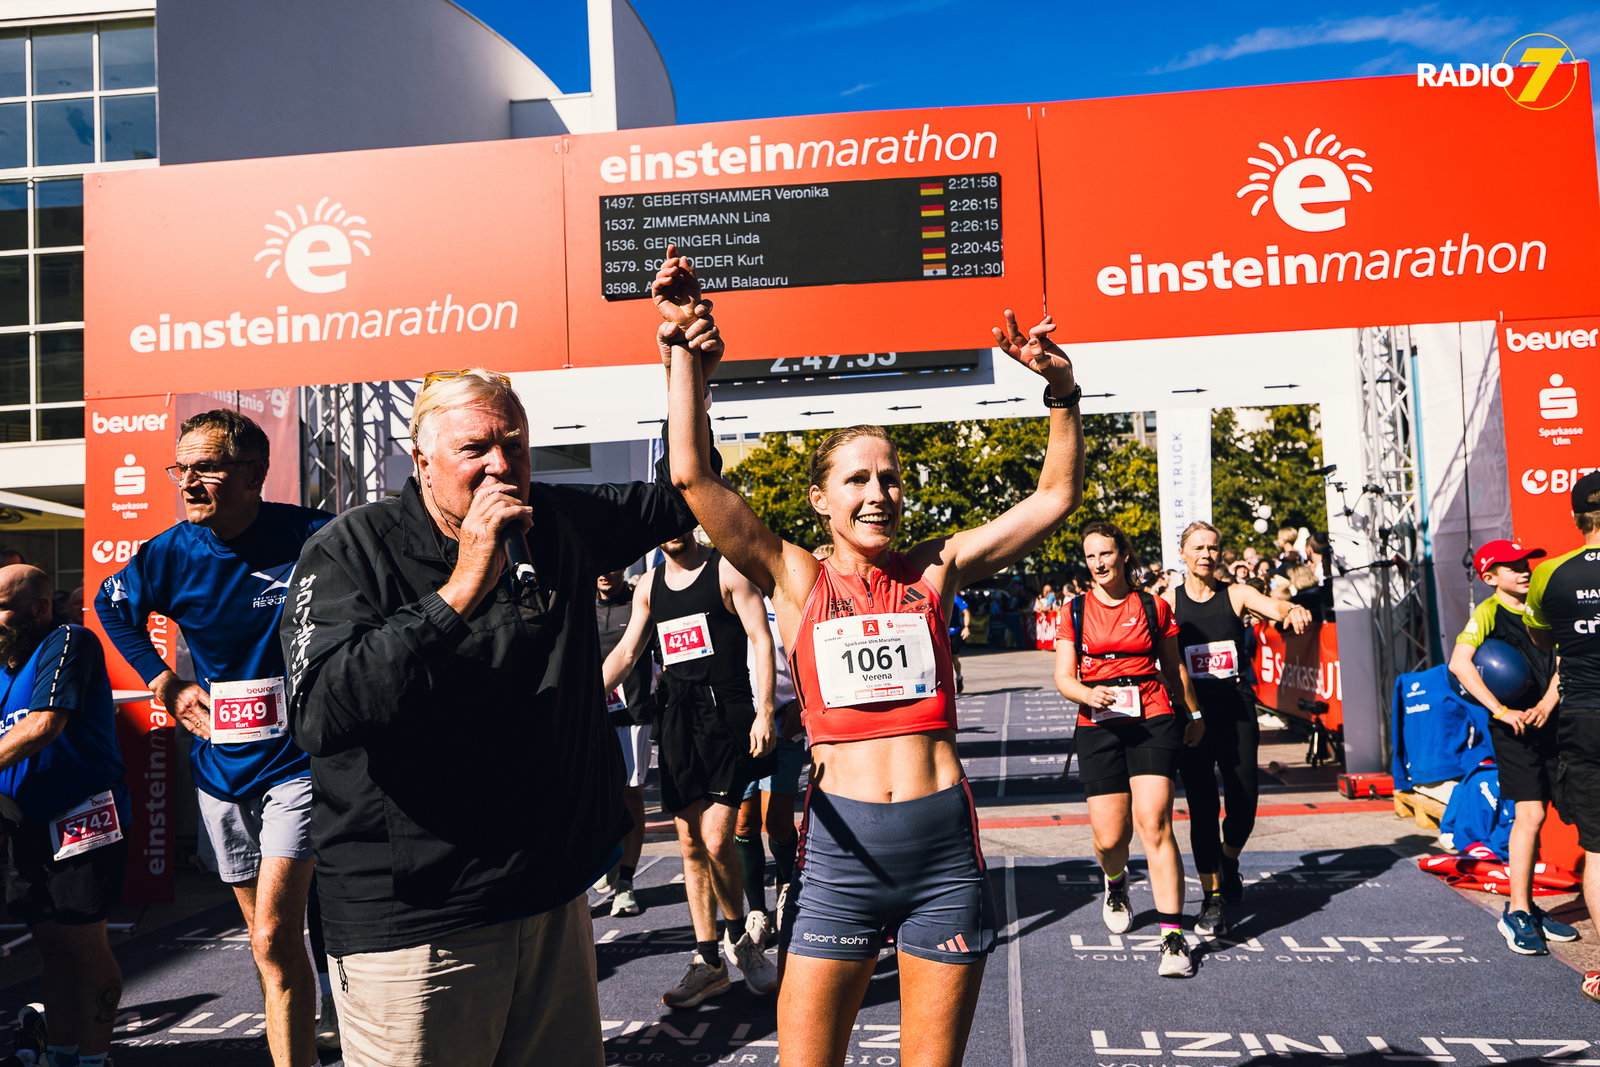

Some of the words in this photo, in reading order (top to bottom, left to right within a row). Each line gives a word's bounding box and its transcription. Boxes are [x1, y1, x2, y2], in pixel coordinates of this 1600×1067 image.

[600, 123, 998, 183] einsteinmarathon
[605, 196, 635, 210] 1497.
[642, 189, 772, 208] GEBERTSHAMMER
[774, 185, 829, 200] Veronika
[948, 175, 998, 190] 2:21:58
[605, 218, 636, 231] 1537.
[643, 213, 740, 229] ZIMMERMANN
[743, 211, 771, 224] Lina
[950, 197, 998, 212] 2:26:15
[605, 239, 639, 252] 1536.
[643, 233, 722, 250] GEISINGER
[725, 232, 760, 245] Linda
[950, 219, 999, 233] 2:26:15
[605, 260, 640, 273] 3579.
[644, 255, 734, 272] SCOEDER
[737, 254, 764, 267] Kurt
[951, 240, 1000, 255] 2:20:45
[1096, 232, 1547, 296] einsteinmarathon
[605, 282, 641, 295] 3598.
[951, 262, 1001, 276] 2:21:30
[129, 293, 519, 354] einsteinmarathon
[1506, 328, 1599, 352] beurer
[92, 412, 168, 434] beurer
[1538, 426, 1583, 438] Sparkasse
[1552, 437, 1571, 446] Ulm
[1172, 432, 1183, 487] TRUCK
[111, 501, 149, 512] Sparkasse
[122, 511, 138, 520] Ulm
[669, 630, 699, 649] 4214
[841, 644, 908, 674] 1061
[1196, 654, 1227, 668] 2907
[862, 673, 893, 682] Verena
[246, 686, 274, 694] beurer
[219, 702, 267, 722] 6349
[65, 811, 113, 838] 5742
[803, 932, 837, 945] sport
[840, 935, 869, 945] sohn
[1075, 954, 1148, 962] YOUR
[1275, 955, 1334, 963] OUR
[1348, 956, 1491, 964] PASSION.
